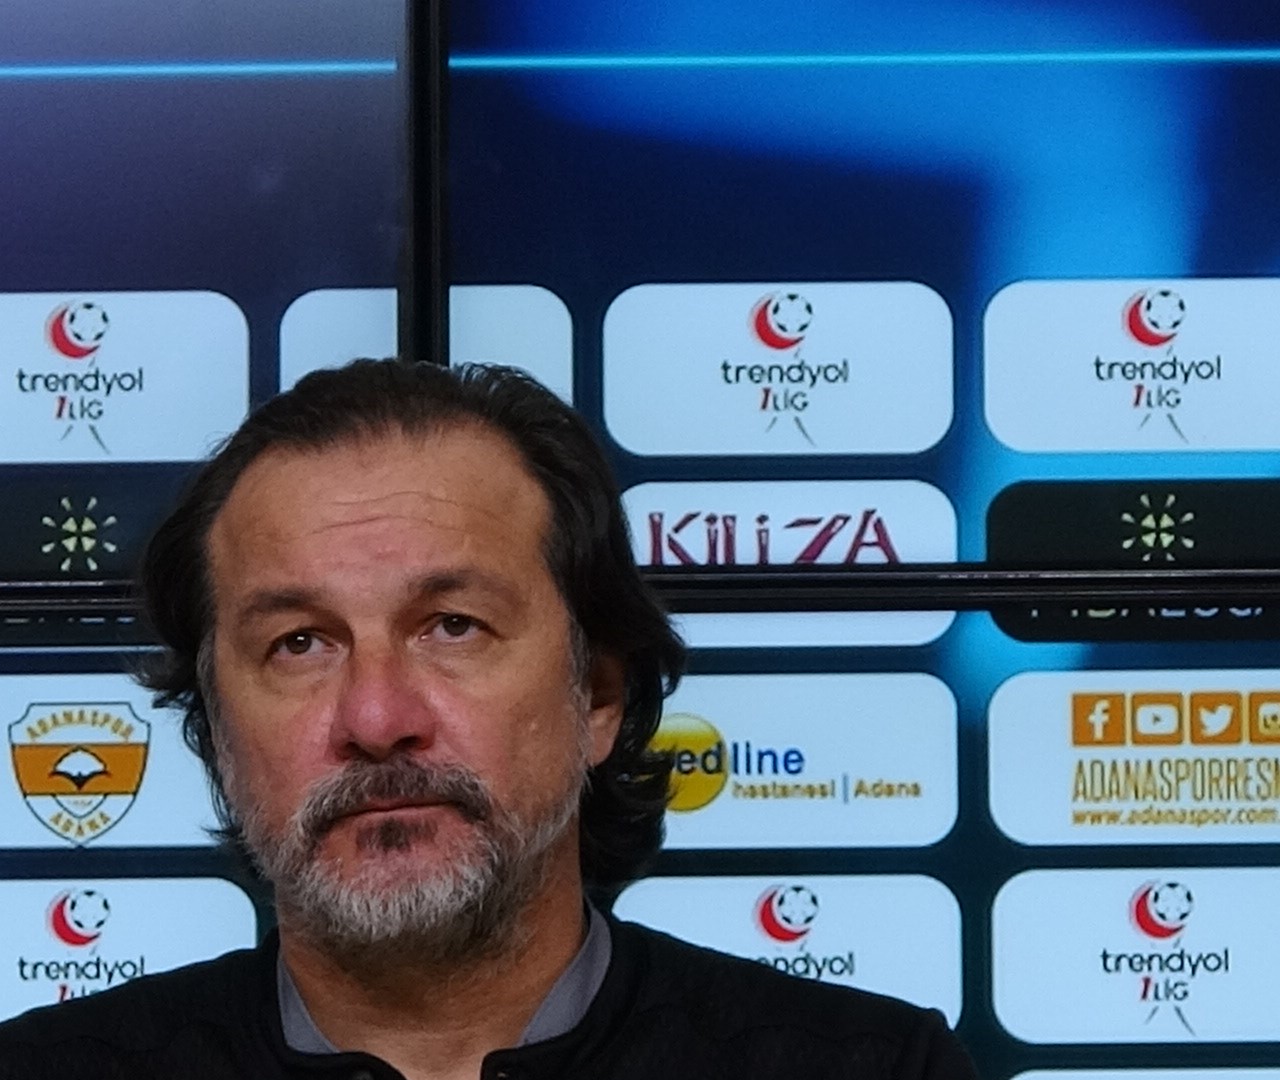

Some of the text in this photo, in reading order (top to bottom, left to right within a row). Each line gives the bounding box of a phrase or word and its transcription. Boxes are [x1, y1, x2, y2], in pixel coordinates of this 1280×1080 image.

[16, 366, 143, 397] trendyol
[721, 356, 849, 389] trendyol
[1094, 352, 1221, 385] trendyol
[1100, 946, 1229, 978] trendyol
